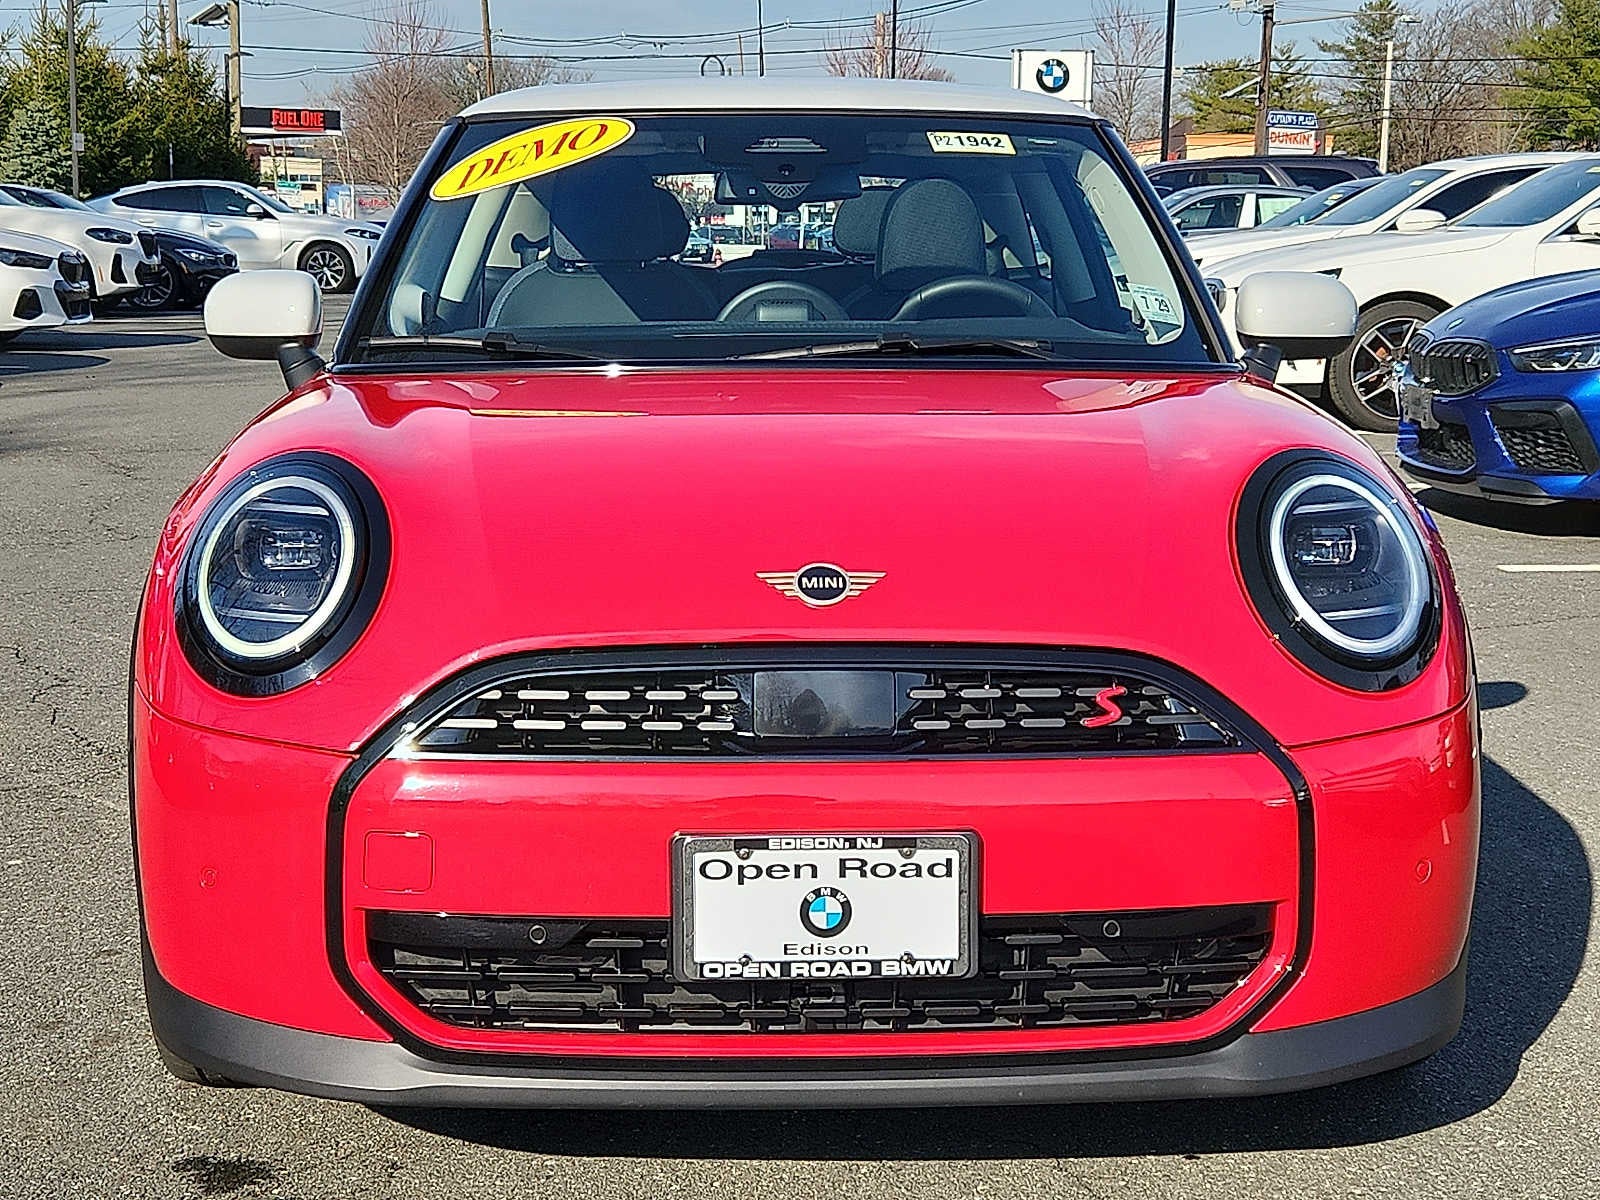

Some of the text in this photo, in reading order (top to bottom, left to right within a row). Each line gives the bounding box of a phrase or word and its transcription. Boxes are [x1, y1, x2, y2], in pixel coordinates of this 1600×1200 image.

[272, 109, 324, 127] FUEL ONE
[455, 123, 609, 192] DEMO
[1140, 295, 1170, 312] 7 29
[801, 576, 844, 589] MINI
[1082, 685, 1128, 728] S
[855, 837, 884, 849] NJ
[699, 857, 954, 885] Open Road
[806, 887, 848, 903] BMW
[783, 943, 869, 956] Edison
[702, 960, 952, 978] OPEN ROAD BMW
